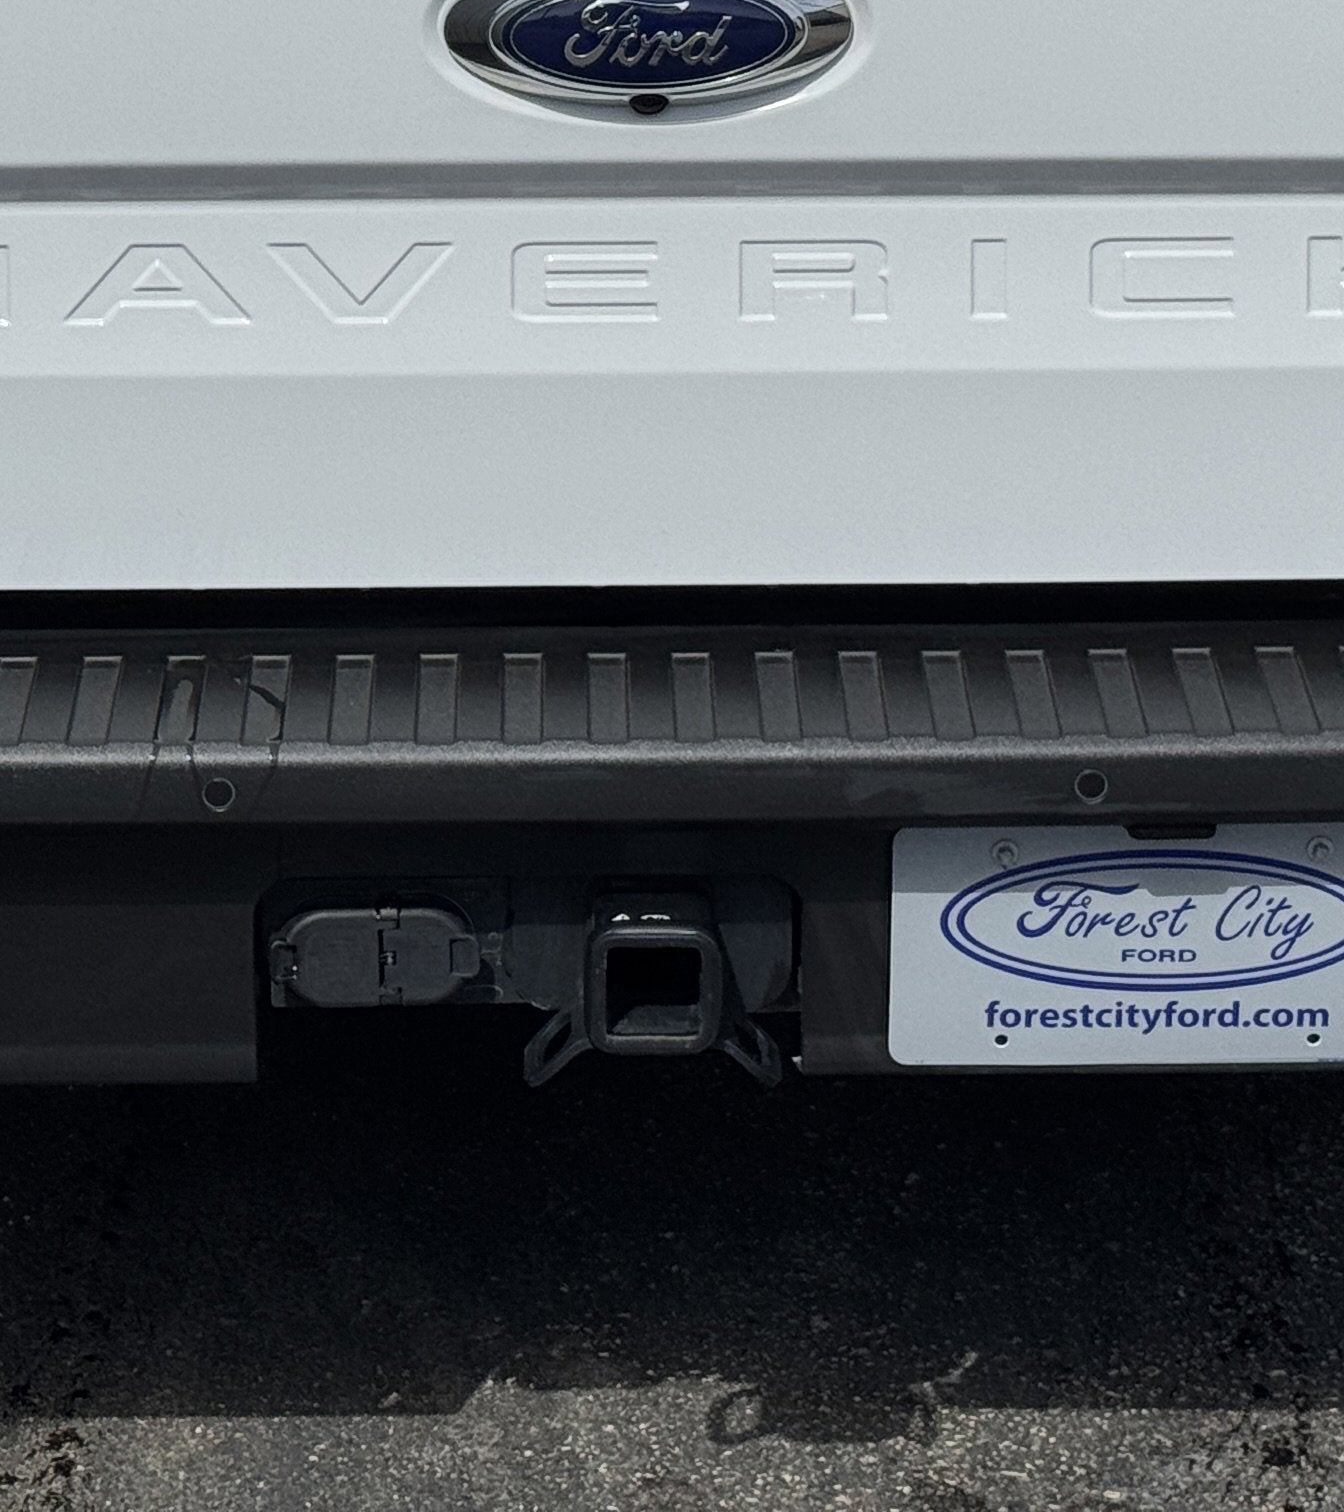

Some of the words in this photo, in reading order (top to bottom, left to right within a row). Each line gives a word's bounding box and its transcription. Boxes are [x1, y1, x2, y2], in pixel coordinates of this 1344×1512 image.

[1016, 880, 1197, 939] Forest
[1214, 884, 1315, 960] City
[1120, 948, 1197, 963] FORD
[985, 1000, 1330, 1035] forestcityford.com
